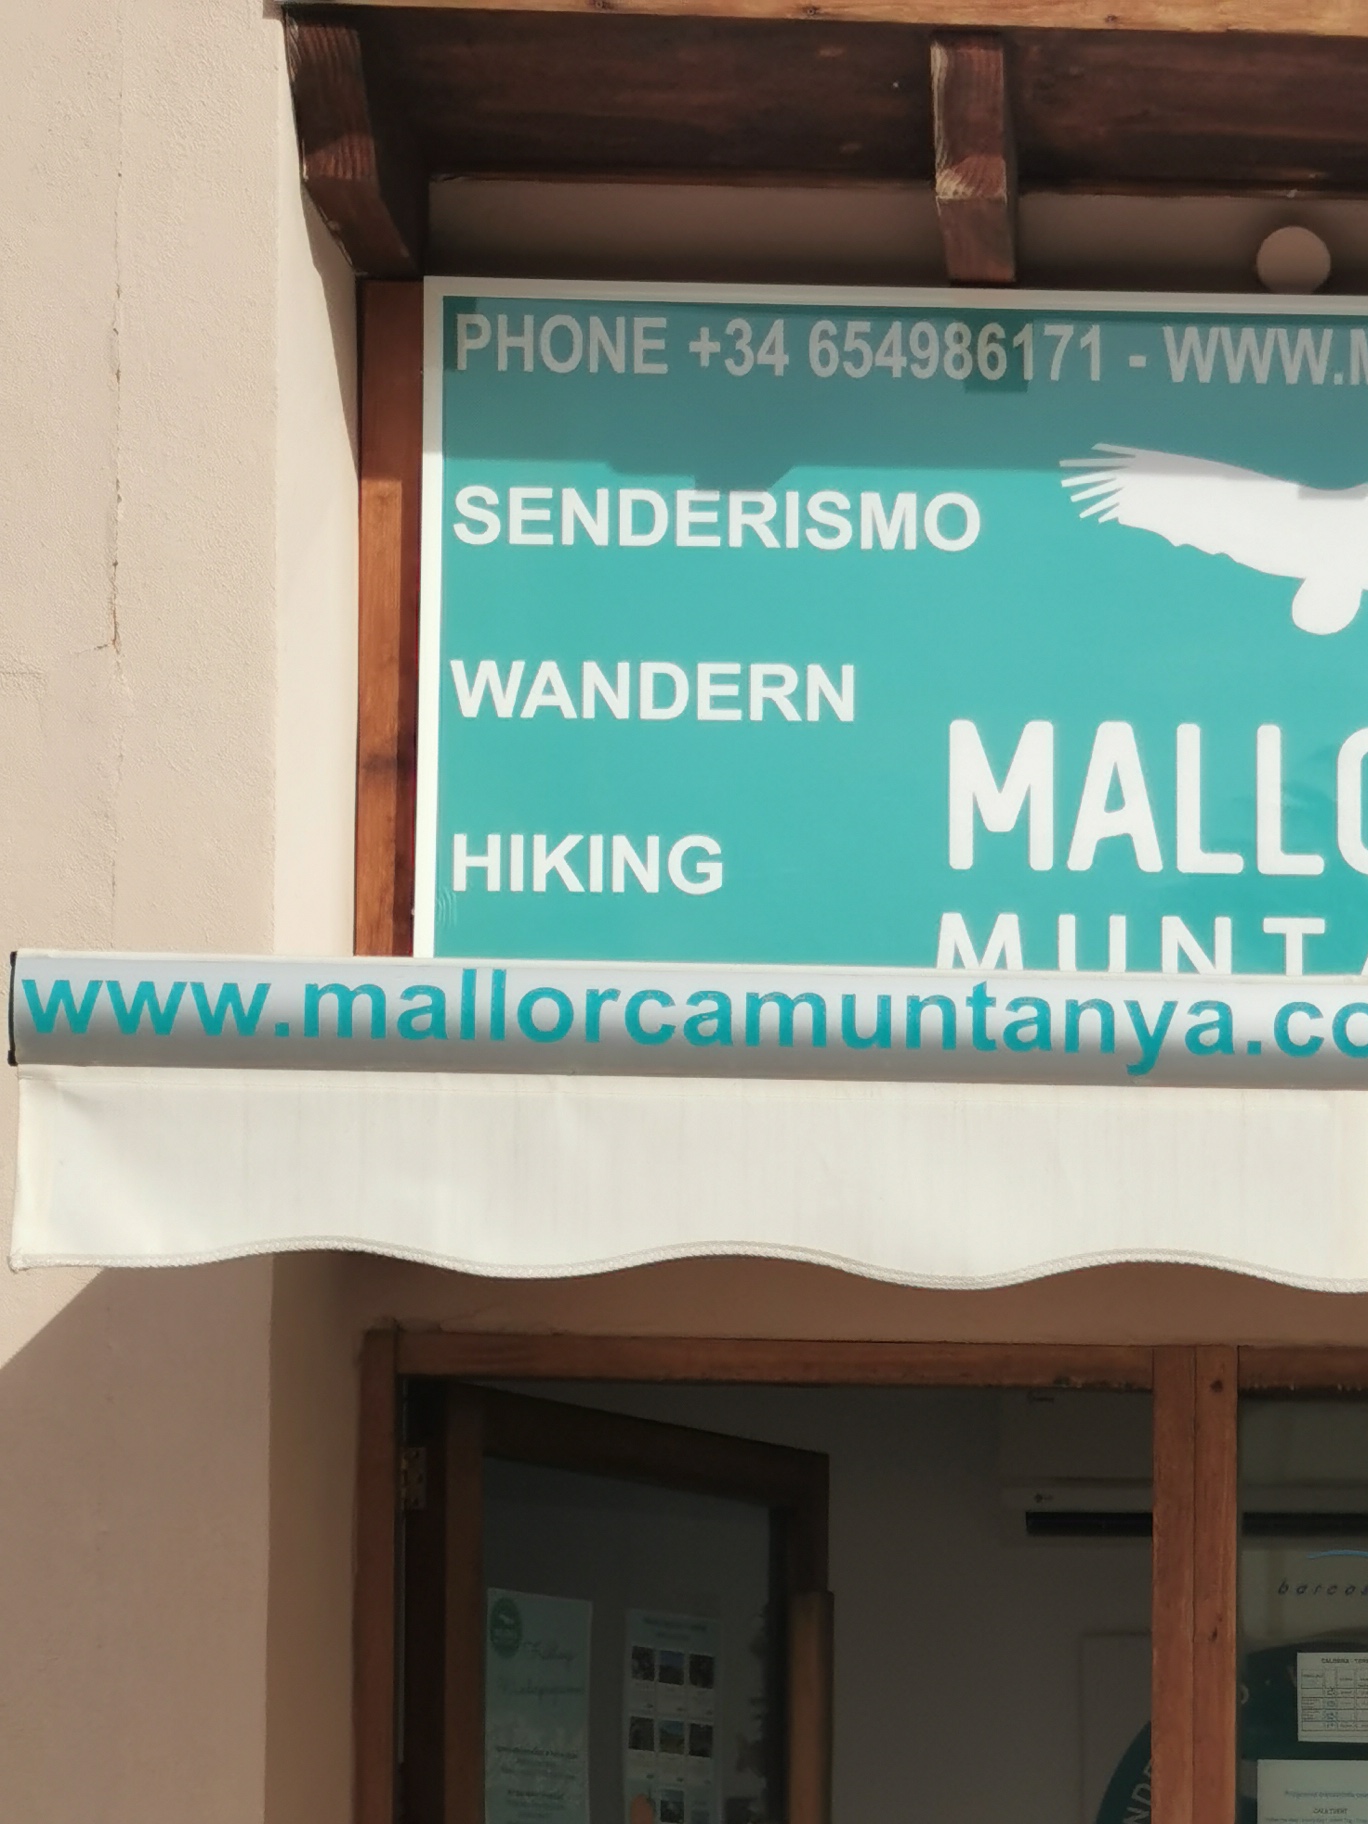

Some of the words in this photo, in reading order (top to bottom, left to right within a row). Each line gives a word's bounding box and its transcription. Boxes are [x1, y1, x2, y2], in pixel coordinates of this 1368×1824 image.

[454, 312, 669, 376] PHONE
[689, 319, 788, 377] +34
[808, 318, 1103, 382] 654986171
[452, 485, 982, 552] SENDERISMO
[451, 660, 857, 722] WANDERN
[452, 832, 724, 895] HIKING
